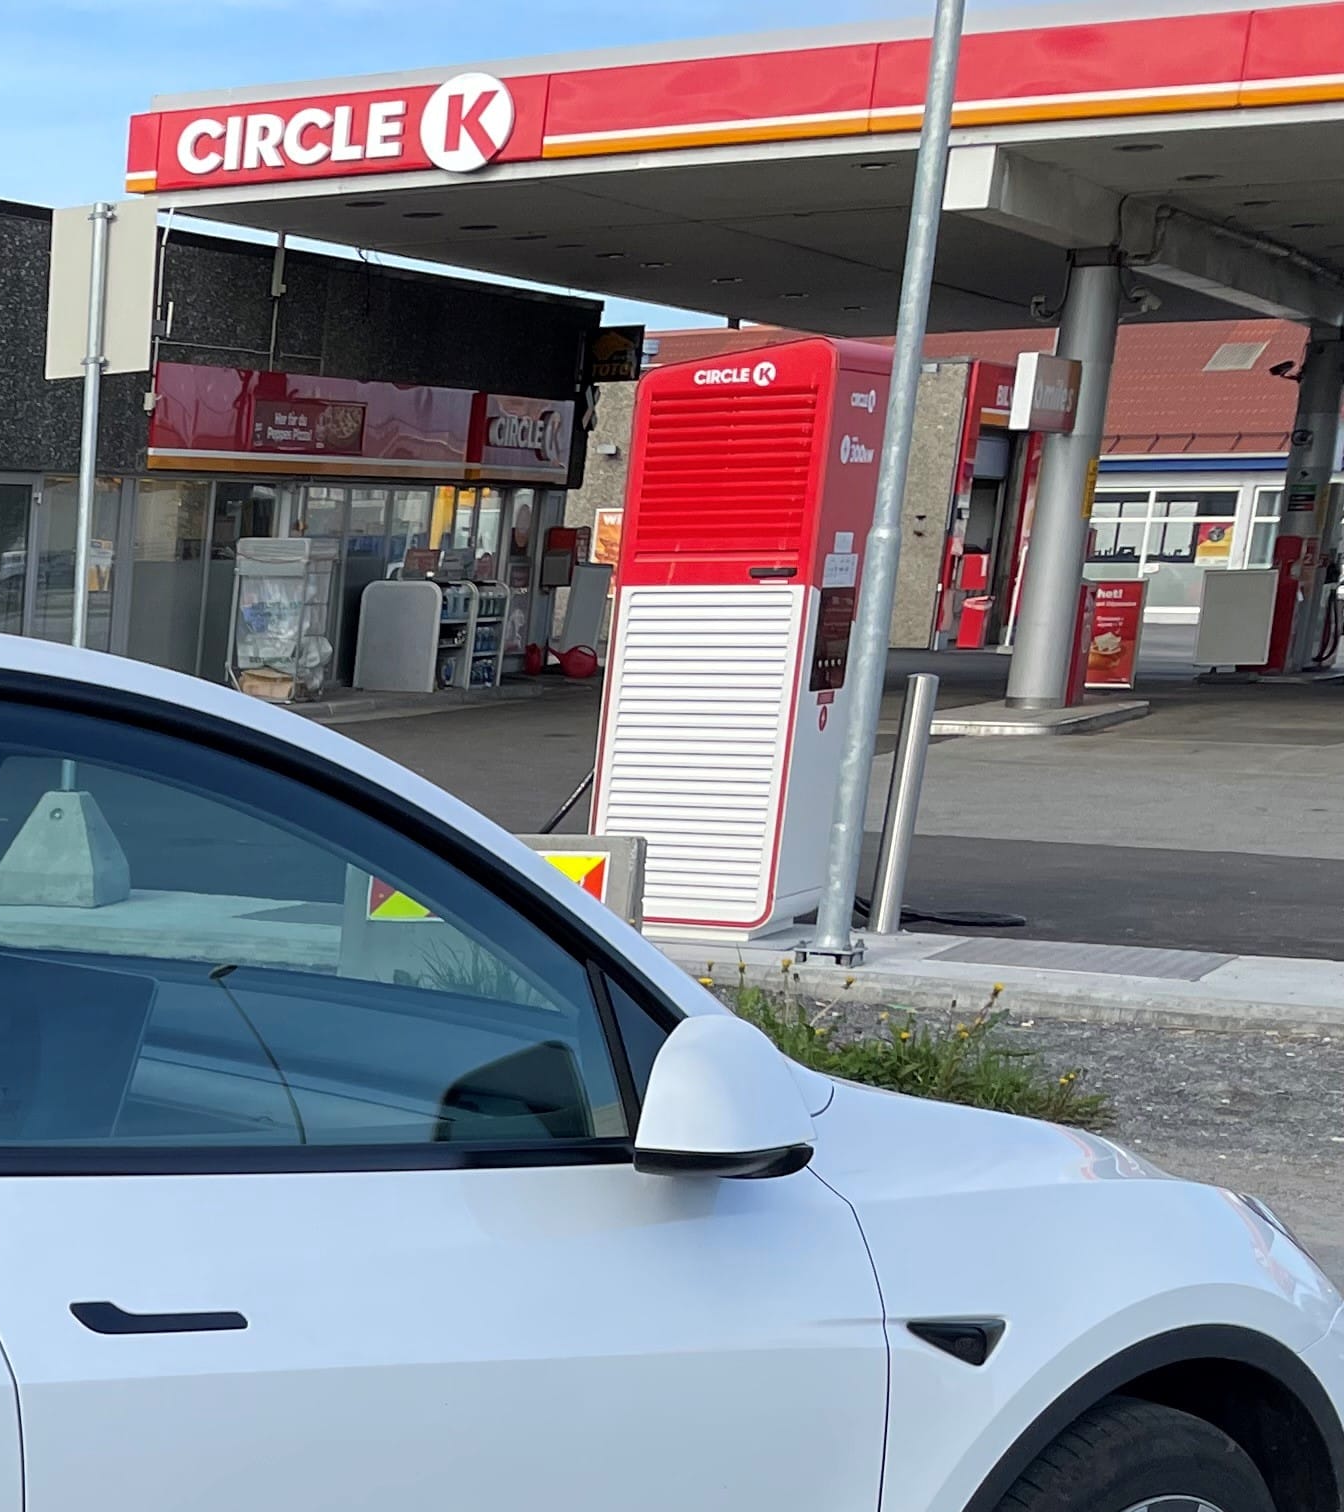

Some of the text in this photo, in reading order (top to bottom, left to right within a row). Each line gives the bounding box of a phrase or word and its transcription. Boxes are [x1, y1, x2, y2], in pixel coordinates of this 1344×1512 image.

[177, 80, 508, 175] CIRCLE K
[693, 363, 775, 385] CIRCLE K
[490, 412, 563, 466] CIRCLE K
